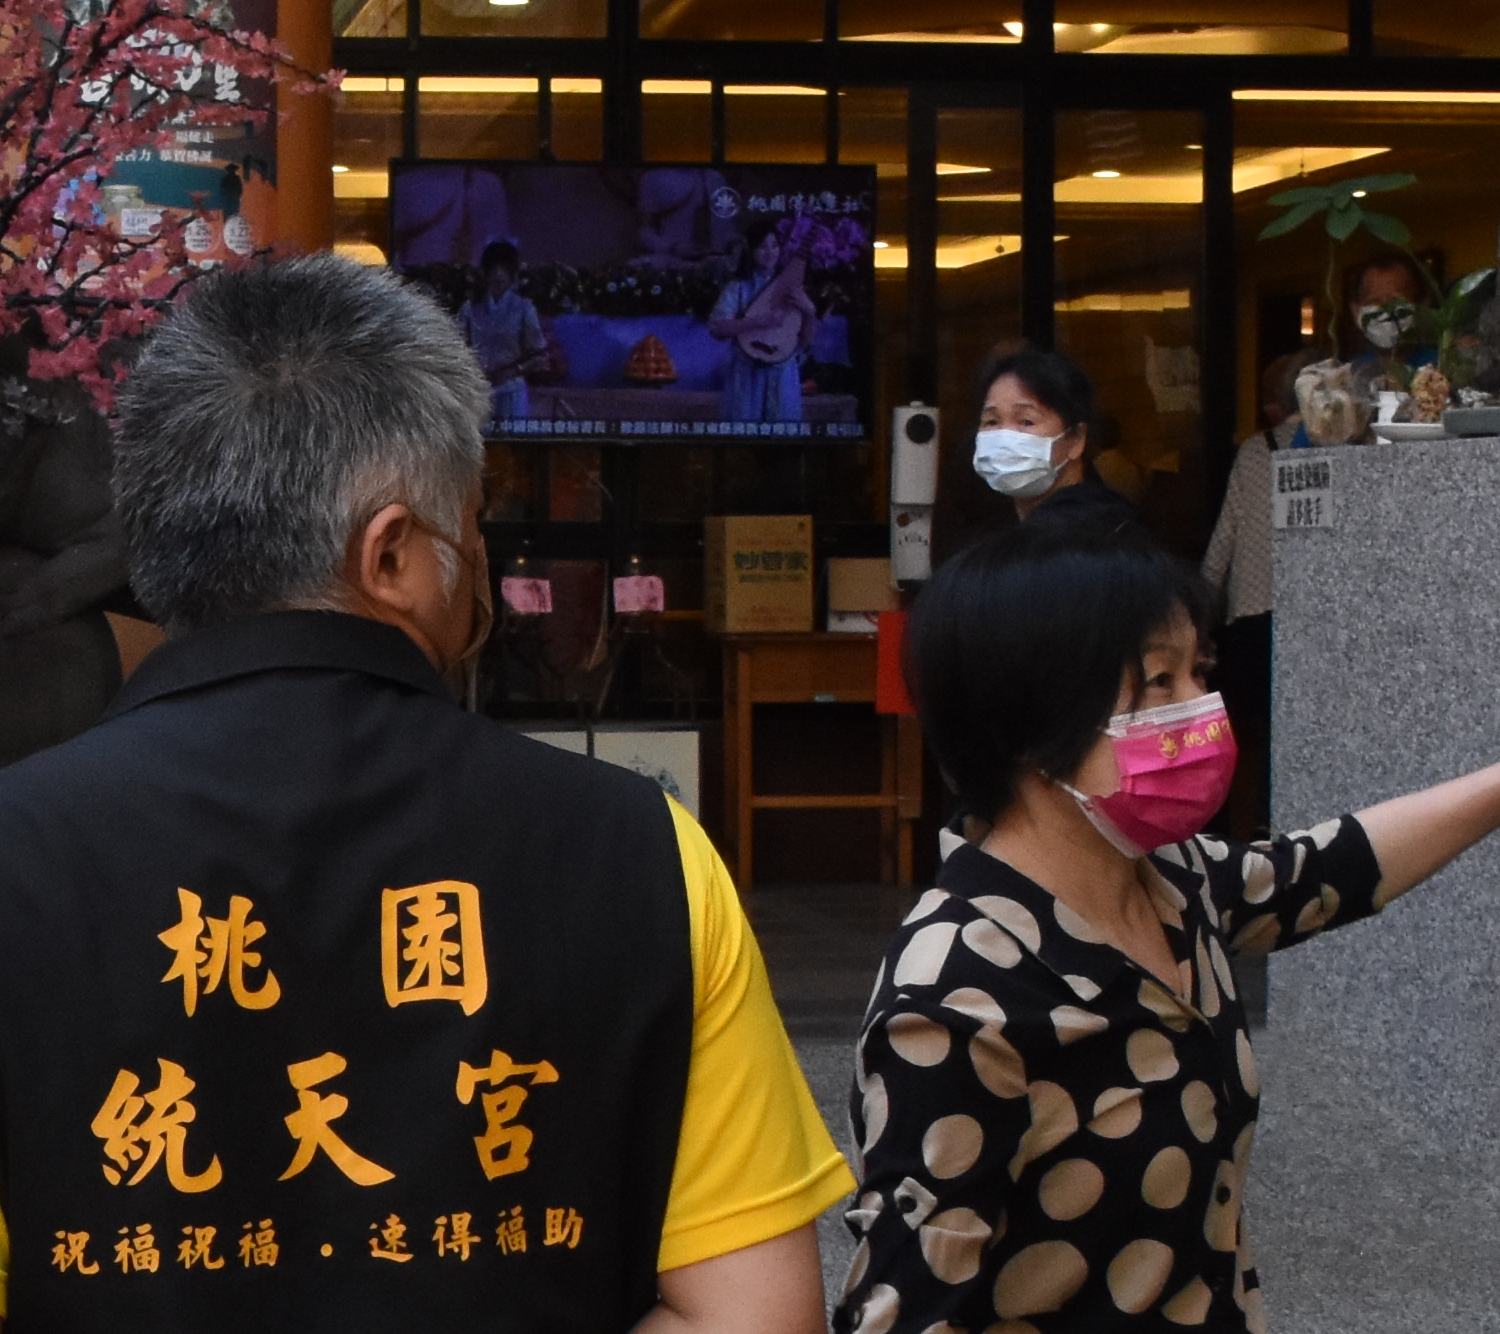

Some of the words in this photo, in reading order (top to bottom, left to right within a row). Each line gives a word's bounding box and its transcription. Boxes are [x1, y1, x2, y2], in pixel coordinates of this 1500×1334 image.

[157, 880, 488, 1017] 桃園
[90, 1049, 560, 1194] 統天宮
